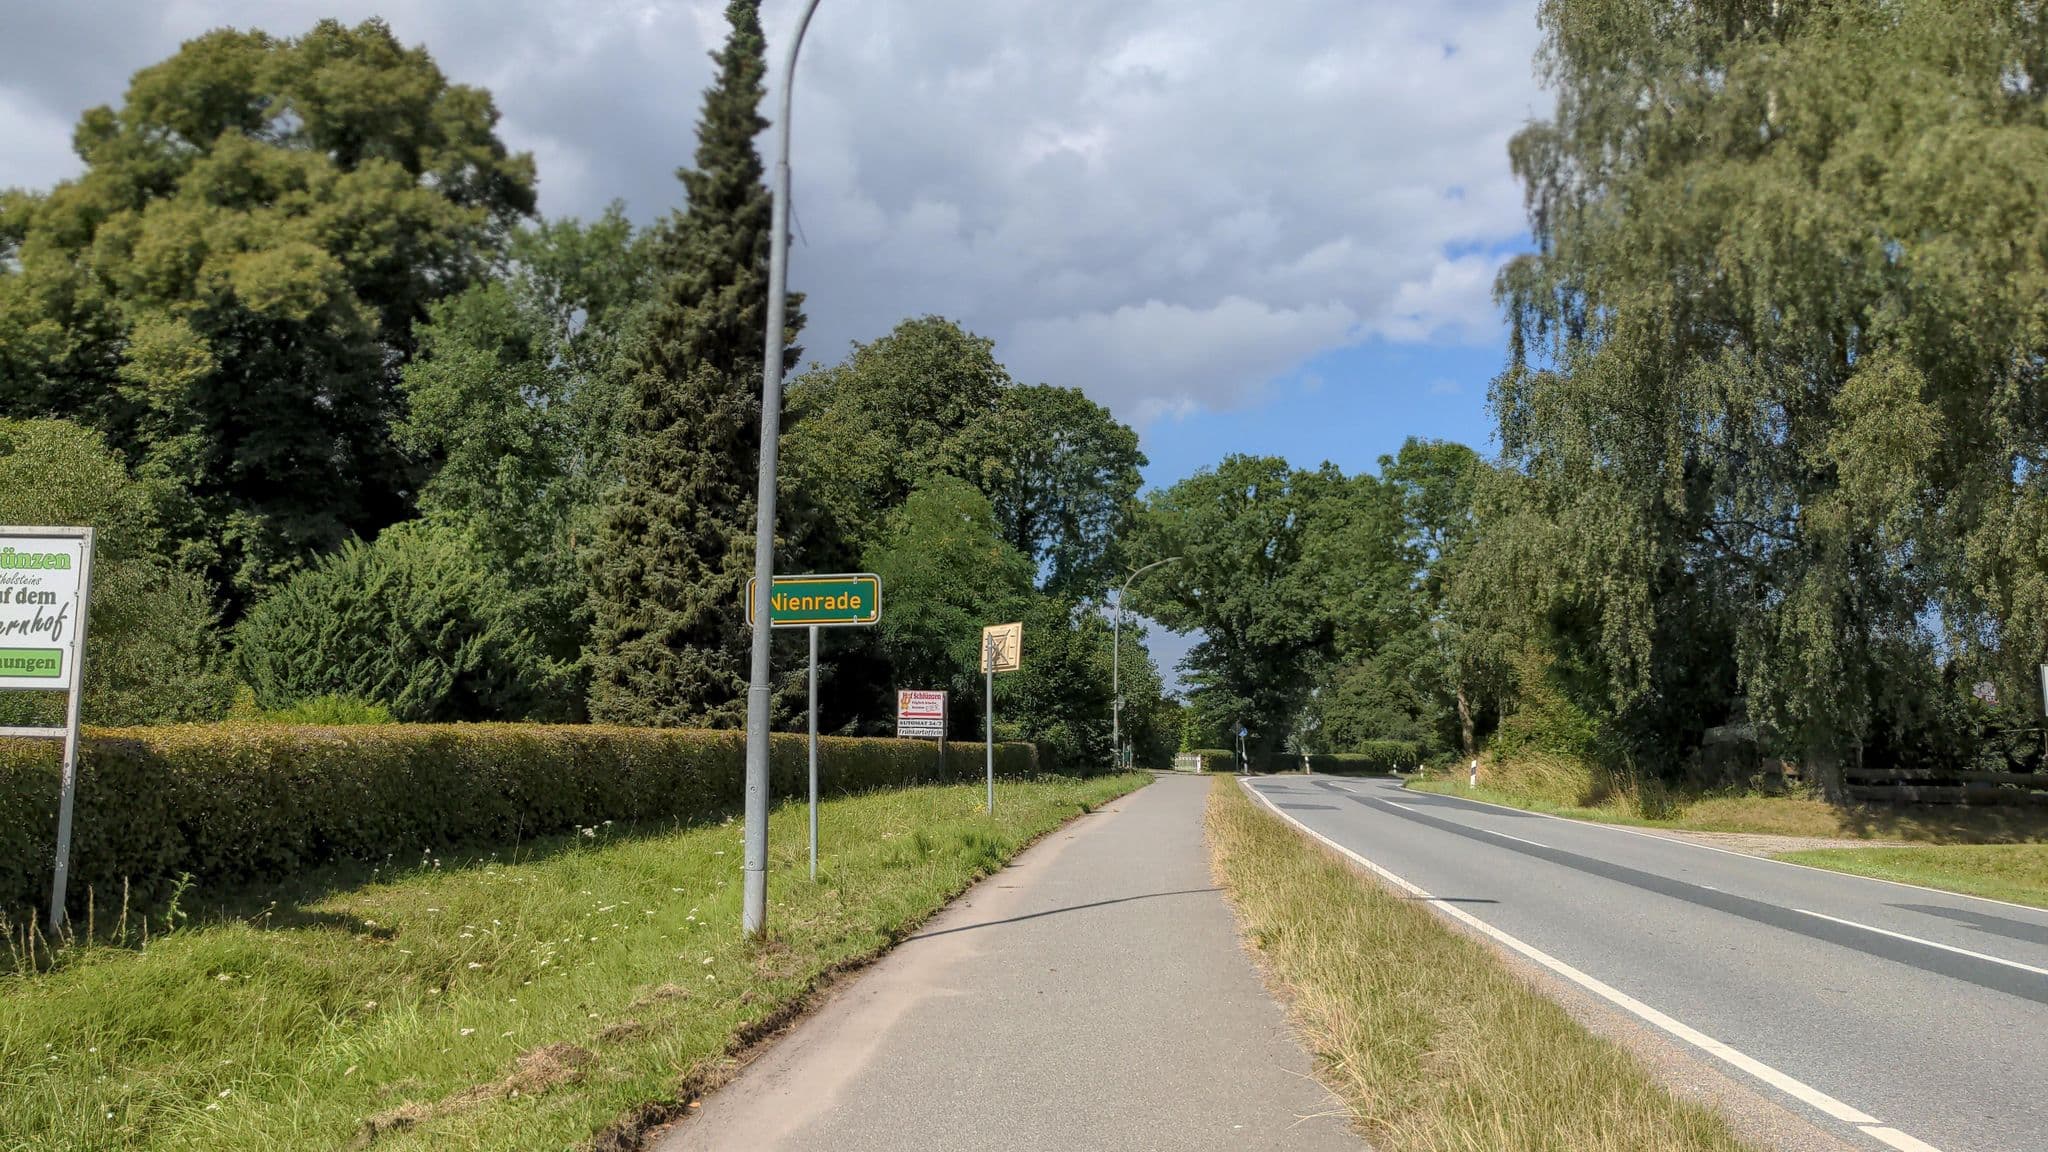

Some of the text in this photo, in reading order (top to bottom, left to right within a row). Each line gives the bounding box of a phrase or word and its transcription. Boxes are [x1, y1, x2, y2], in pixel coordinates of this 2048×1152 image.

[0, 572, 42, 585] holsteins
[15, 587, 56, 604] dem
[771, 592, 861, 611] Nienrade
